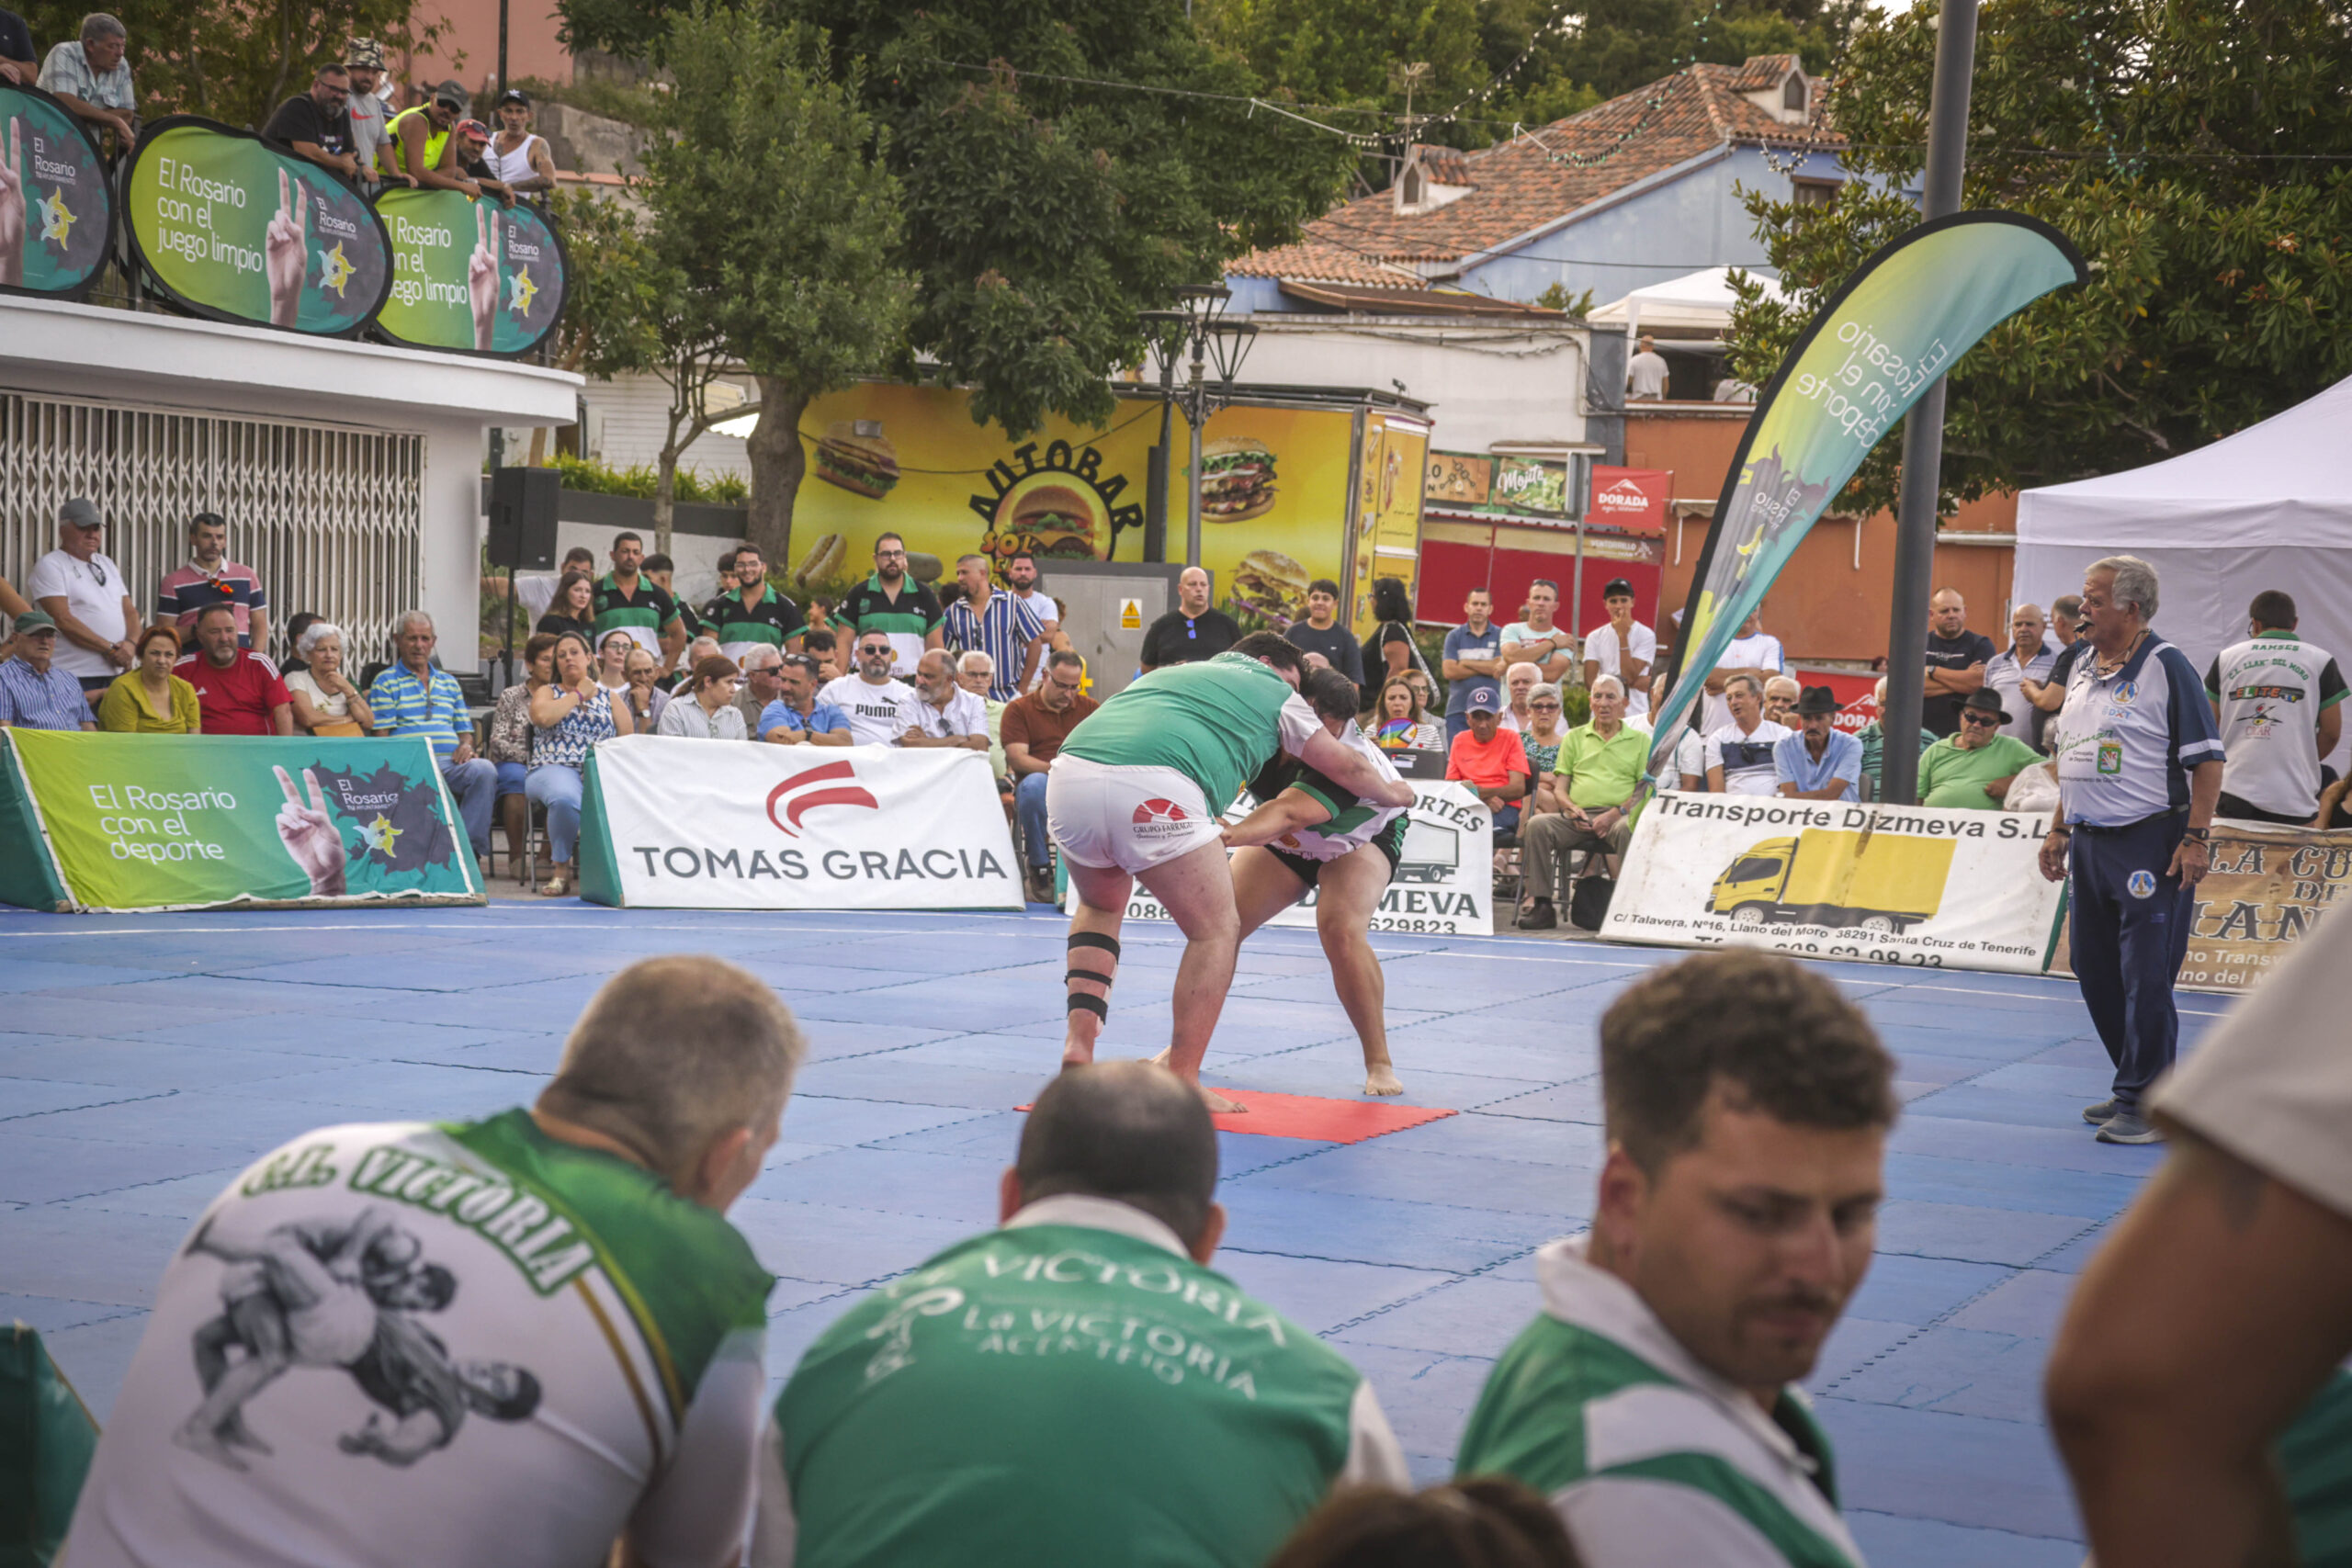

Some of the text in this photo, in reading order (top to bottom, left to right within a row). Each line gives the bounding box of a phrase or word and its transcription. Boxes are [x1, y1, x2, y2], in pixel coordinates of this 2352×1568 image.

[34, 137, 44, 153] El
[34, 155, 75, 177] Rosario
[158, 157, 246, 209] El Rosario
[157, 196, 213, 230] con el
[316, 197, 328, 211] El
[319, 211, 356, 233] Rosario
[397, 216, 452, 249] Rosario
[508, 225, 516, 239] El
[156, 220, 263, 275] juego limpio
[410, 246, 425, 274] el
[508, 239, 540, 256] Rosario
[424, 274, 468, 310] limpio
[968, 439, 1144, 534] AUTOBAR
[1598, 492, 1649, 508] DORADA
[979, 530, 1034, 556] SOL
[2251, 644, 2301, 652] RAMSES
[2271, 658, 2287, 668] DEL
[2289, 662, 2310, 681] MORO
[2235, 686, 2282, 699] ELITE
[1832, 712, 1876, 728] DORA
[88, 784, 237, 811] El Rosario
[337, 779, 353, 792] El
[341, 791, 399, 806] Rosario
[100, 810, 192, 837] con el
[1133, 824, 1161, 834] GRUPO
[1657, 794, 1832, 830] Transporte
[1842, 807, 1985, 838] Dizmeva
[110, 835, 226, 865] deporte
[2208, 840, 2266, 874] LA
[821, 848, 1008, 880] GRACIA
[1613, 913, 1628, 923] C/
[1632, 914, 1688, 928] Talavera,
[1730, 922, 1768, 935] Llano
[1771, 926, 1792, 937] del
[1796, 927, 1828, 939] Moro
[1835, 929, 1874, 942] 38291
[1879, 933, 1918, 945] Santa
[1922, 936, 1954, 949] Cruz
[1959, 940, 1975, 950] de
[1980, 942, 2037, 957] Tenerife
[2214, 969, 2246, 985] del
[348, 1145, 599, 1298] VICTORIA
[985, 1249, 1286, 1348] VICTORIA
[963, 1305, 1258, 1402] La VICTORIA
